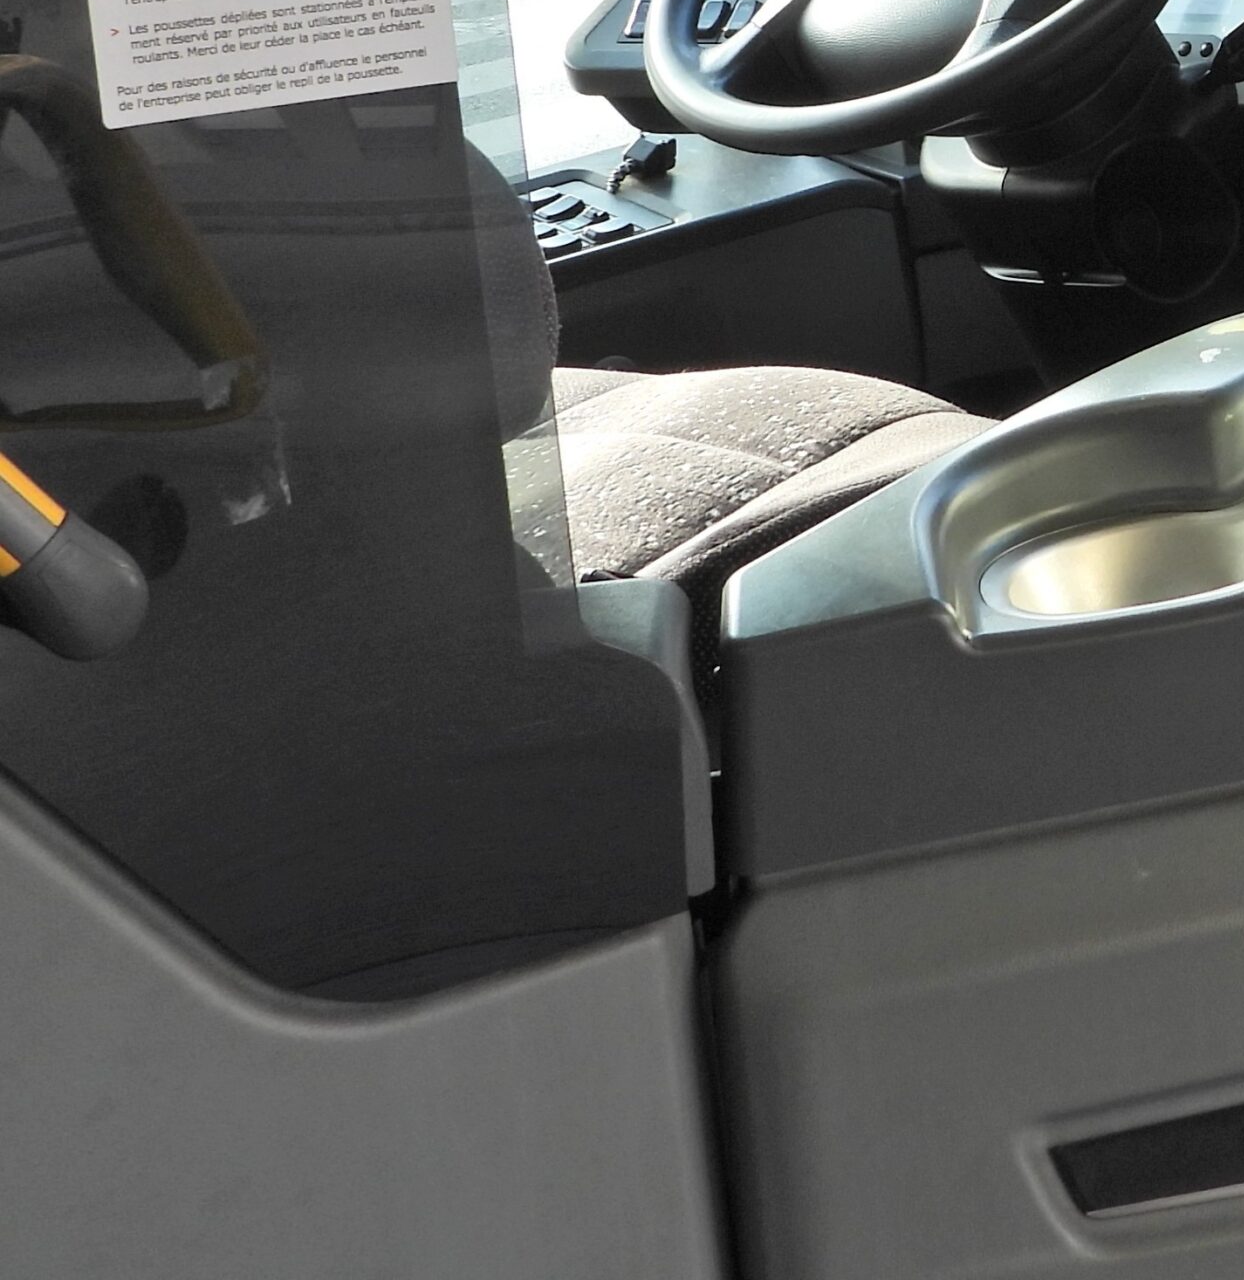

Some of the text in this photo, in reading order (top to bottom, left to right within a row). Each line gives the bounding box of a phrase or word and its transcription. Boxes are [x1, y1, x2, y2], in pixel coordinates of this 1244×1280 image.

[128, 23, 149, 35] Les
[153, 15, 216, 33] poussettes
[220, 9, 267, 25] dépliées
[272, 6, 296, 18] sont
[130, 3, 435, 49] ment réservé par priorité aux utilisateurs en fauteuils
[132, 19, 425, 64] roulants. Merci de leur céder la place le cas échéant.
[116, 46, 428, 96] Pour des raisons de sécurité ou d'affluence le personnel
[118, 65, 403, 111] de l'entreprise peut obliger le repli de la poussette.
